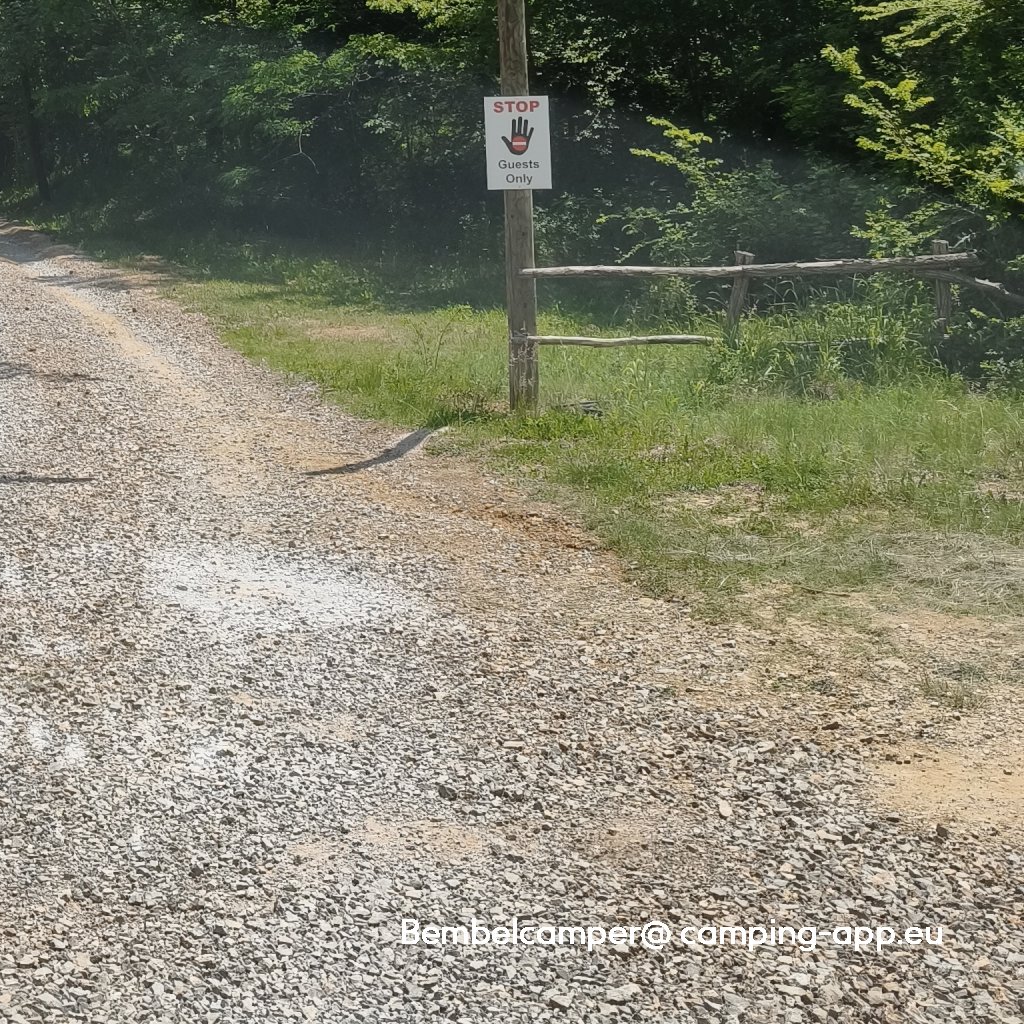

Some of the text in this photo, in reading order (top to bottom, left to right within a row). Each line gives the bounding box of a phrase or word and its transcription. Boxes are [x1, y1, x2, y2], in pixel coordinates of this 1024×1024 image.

[493, 101, 540, 113] STOP
[498, 159, 540, 170] Guests
[506, 173, 533, 185] Only
